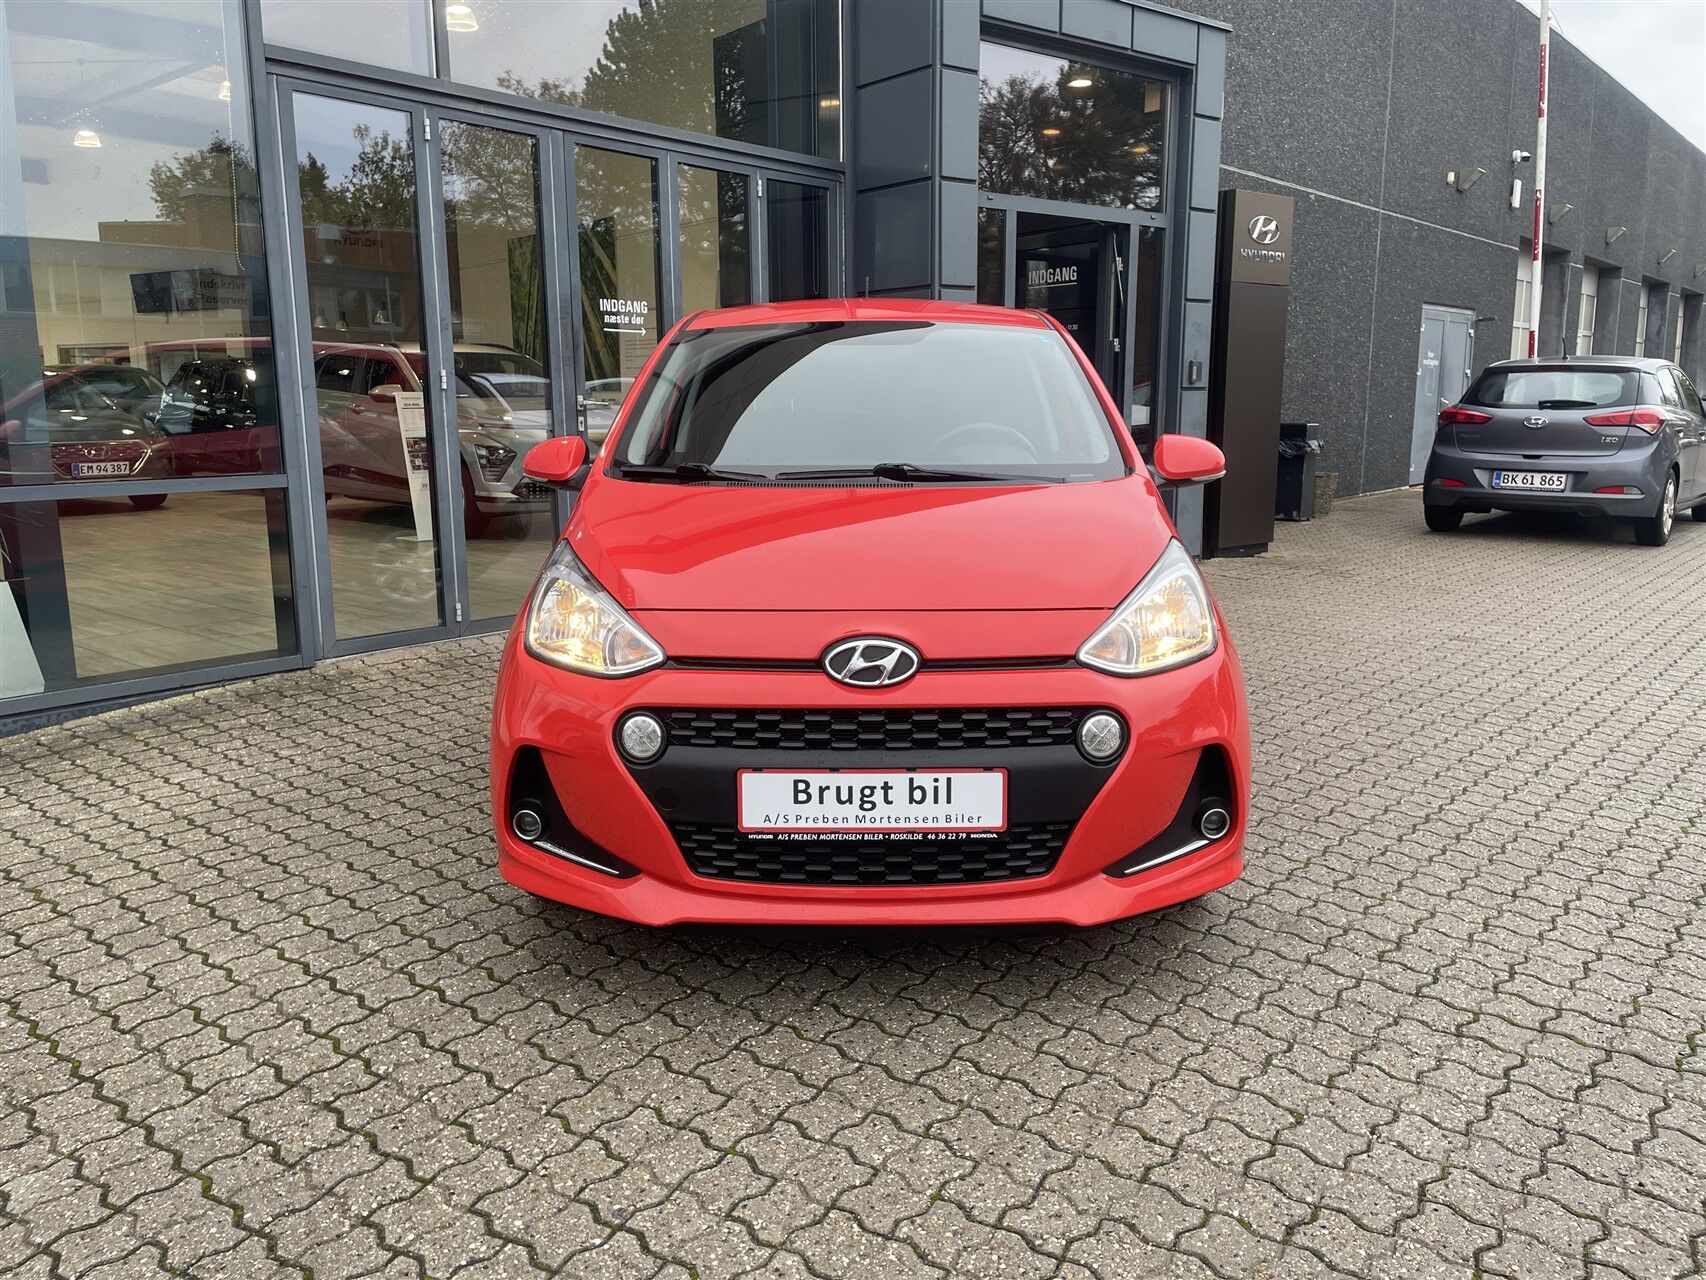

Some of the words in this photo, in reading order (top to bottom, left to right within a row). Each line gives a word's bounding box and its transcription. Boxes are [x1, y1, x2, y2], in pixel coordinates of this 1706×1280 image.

[1240, 248, 1285, 263] HYUNDAI
[1028, 266, 1078, 284] INDGANG
[599, 299, 648, 313] INDGANG
[604, 315, 630, 324] næste
[631, 314, 645, 325] dør
[80, 465, 94, 475] EM
[96, 464, 109, 474] 94
[110, 463, 128, 473] 387
[1502, 473, 1519, 485] BK
[1521, 474, 1535, 486] 61
[1540, 475, 1564, 487] 865
[793, 779, 894, 811] Brugt
[908, 777, 952, 805] bil
[763, 813, 790, 825] A/S
[795, 814, 849, 824] Preben
[855, 813, 939, 824] Mortensen
[945, 813, 982, 823] Biler
